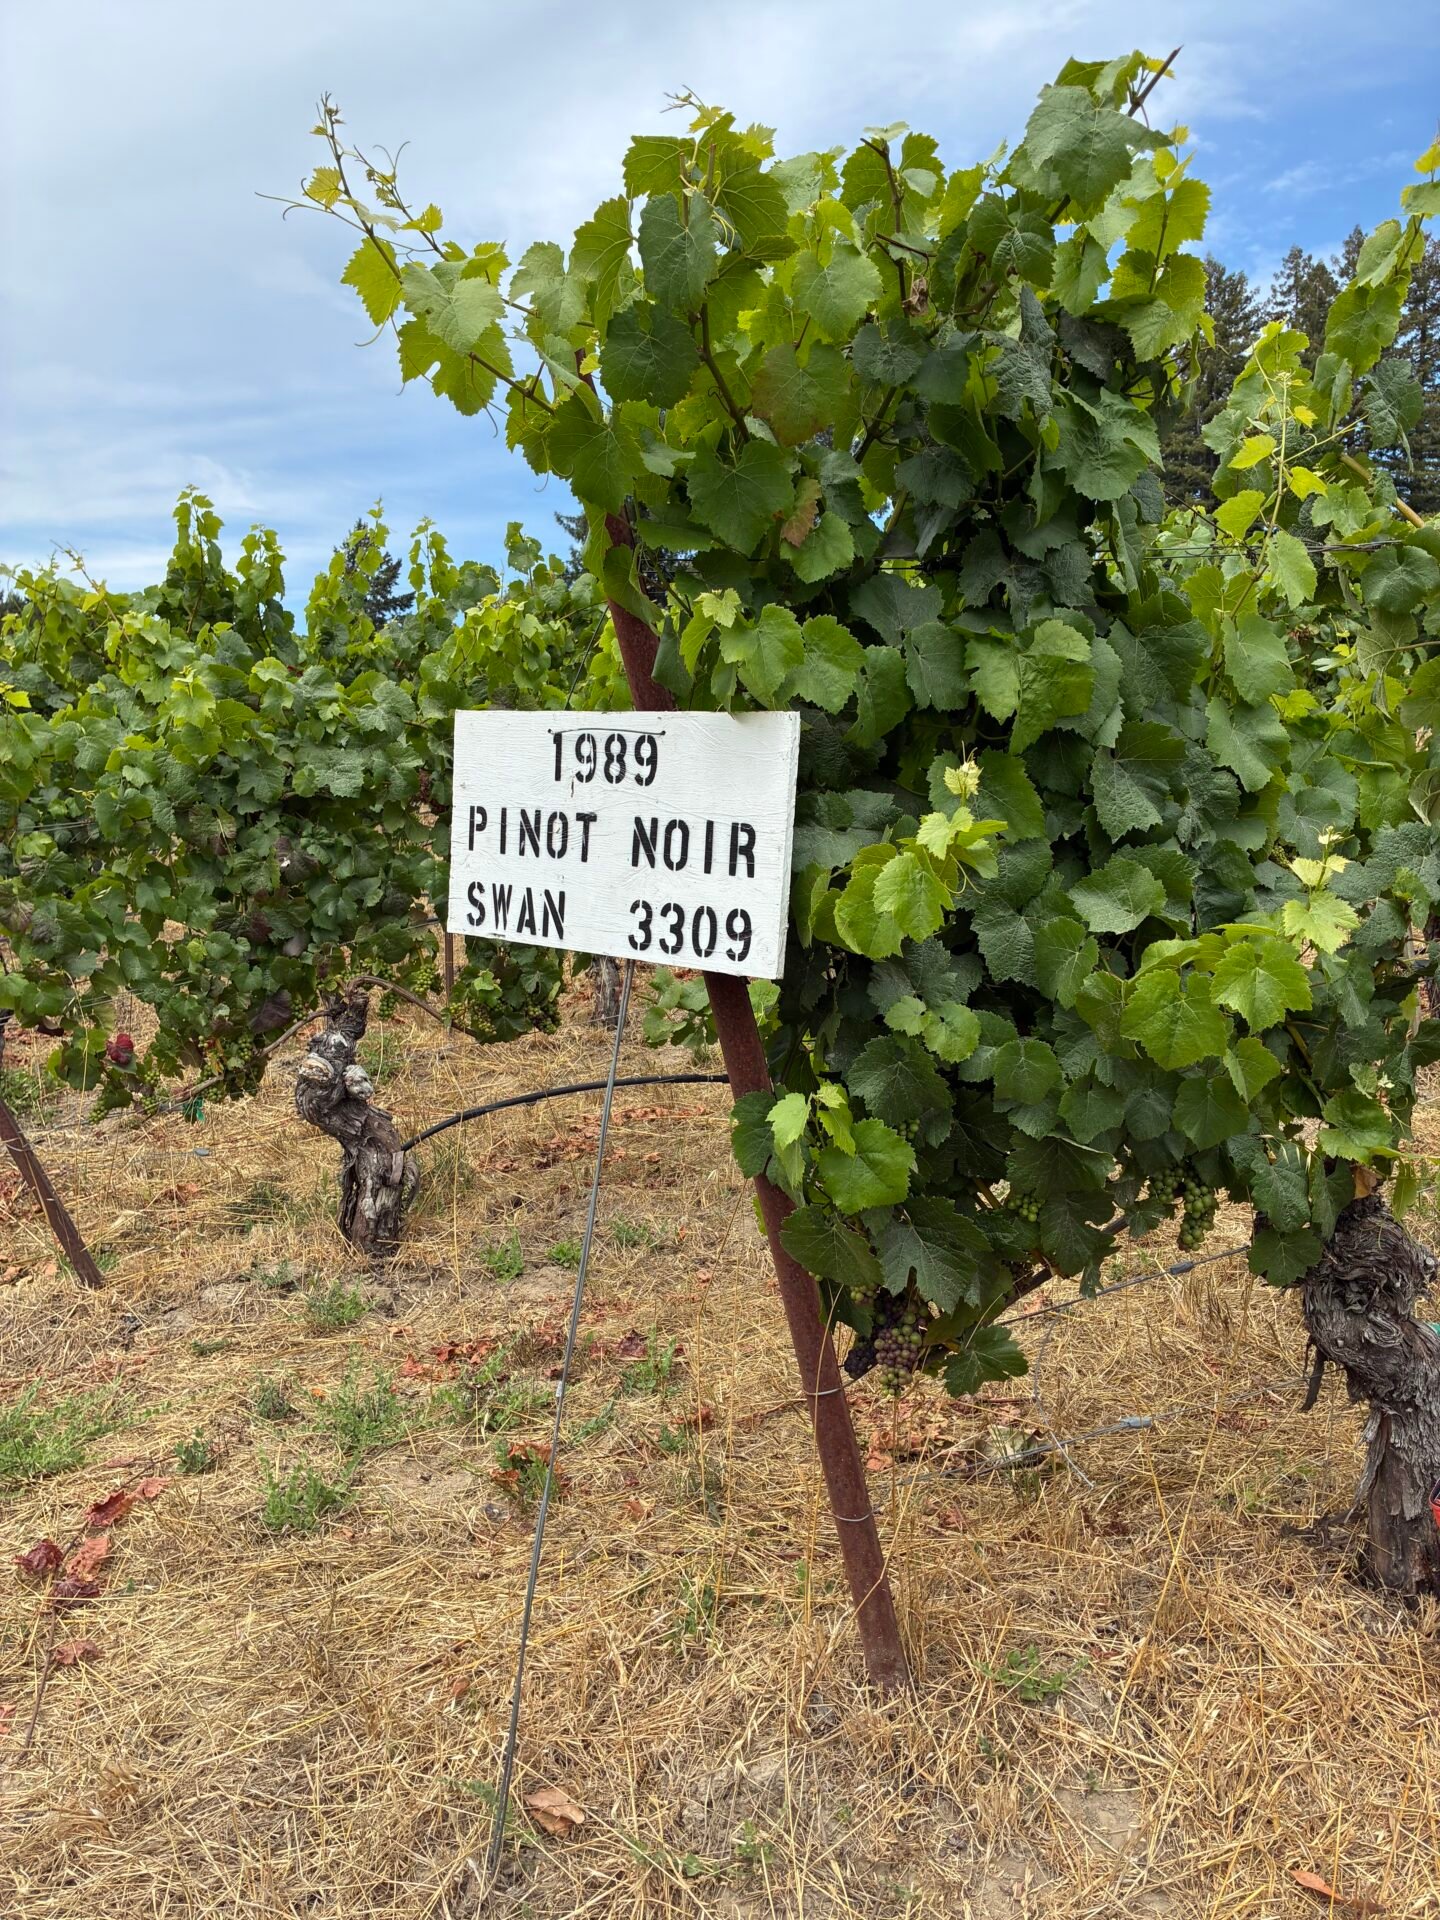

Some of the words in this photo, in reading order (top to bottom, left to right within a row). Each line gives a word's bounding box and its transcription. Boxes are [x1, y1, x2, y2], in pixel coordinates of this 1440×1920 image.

[552, 732, 658, 787] 1989
[468, 805, 598, 863] PINOT
[631, 816, 756, 879] NOIR
[466, 881, 566, 940] SWAN
[628, 899, 753, 962] 3309
